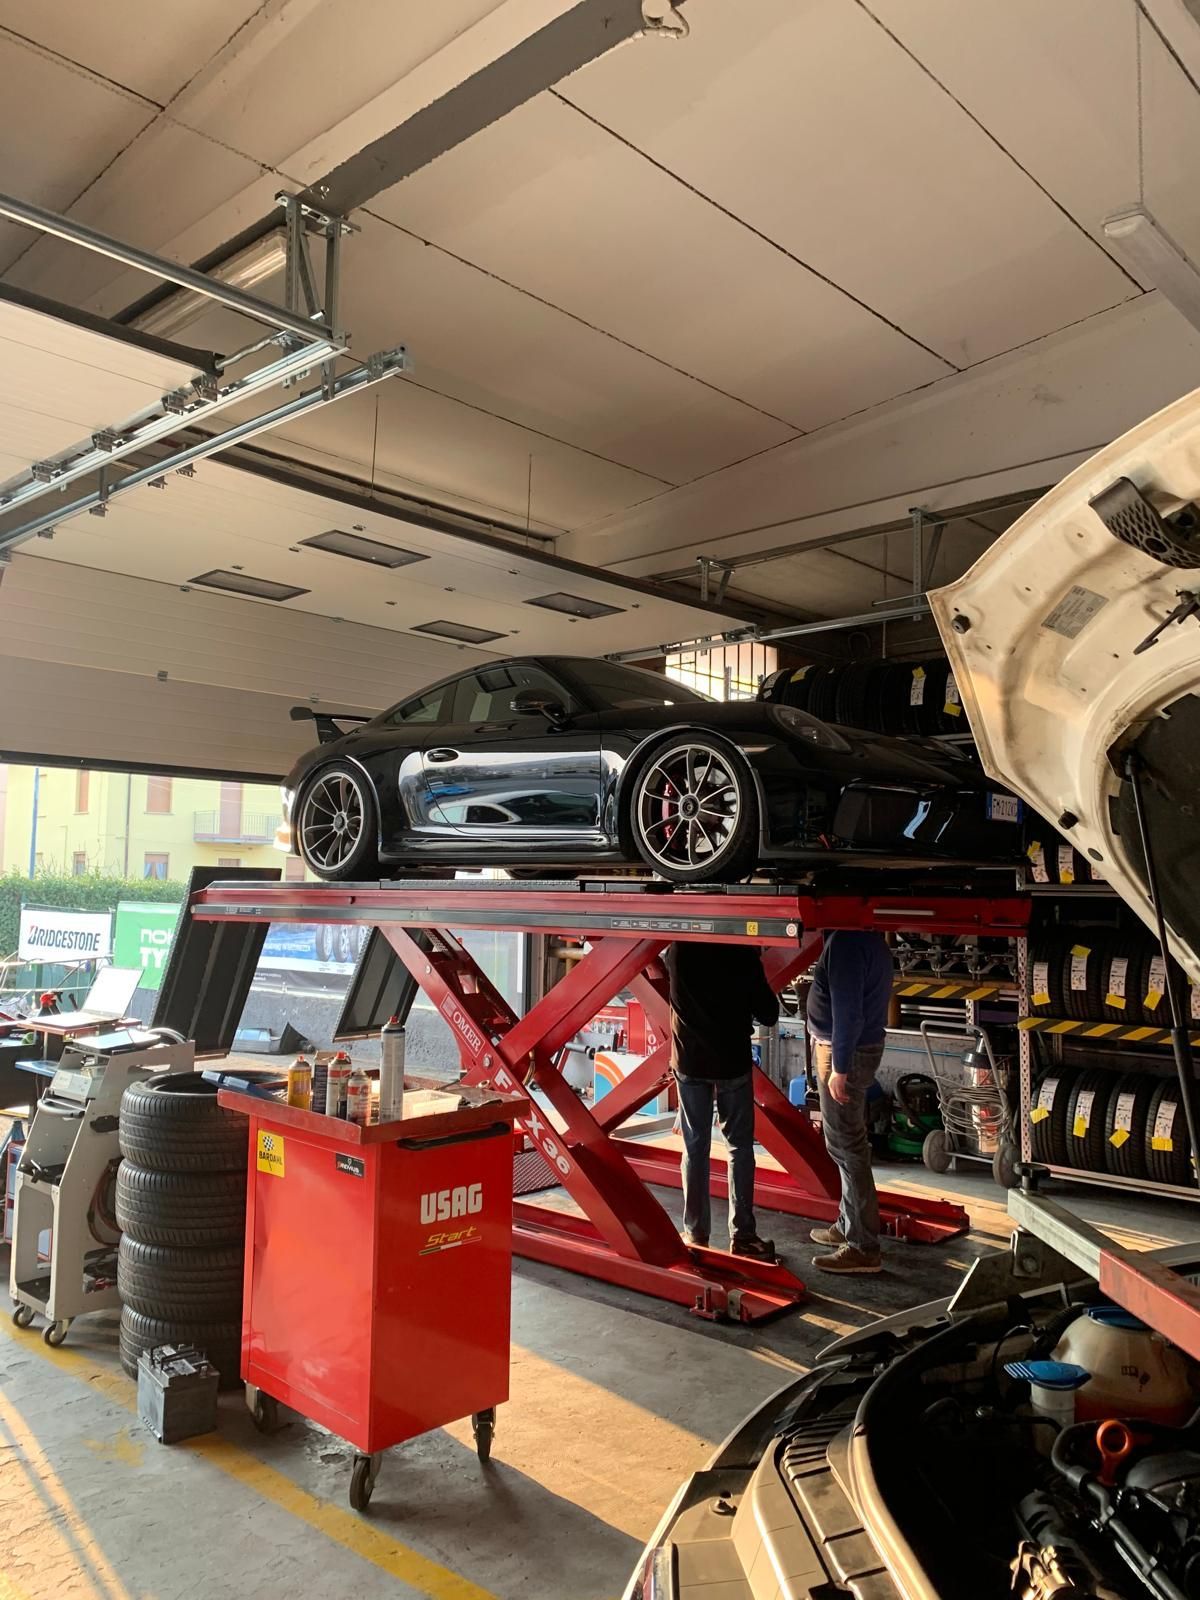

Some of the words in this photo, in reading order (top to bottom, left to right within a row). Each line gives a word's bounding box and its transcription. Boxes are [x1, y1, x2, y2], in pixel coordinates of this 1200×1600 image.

[27, 925, 101, 951] BRIDGESTONE
[452, 1010, 481, 1053] OMER
[259, 1150, 283, 1166] BARDAHL
[420, 1182, 483, 1225] USAG
[425, 1226, 477, 1247] Start
